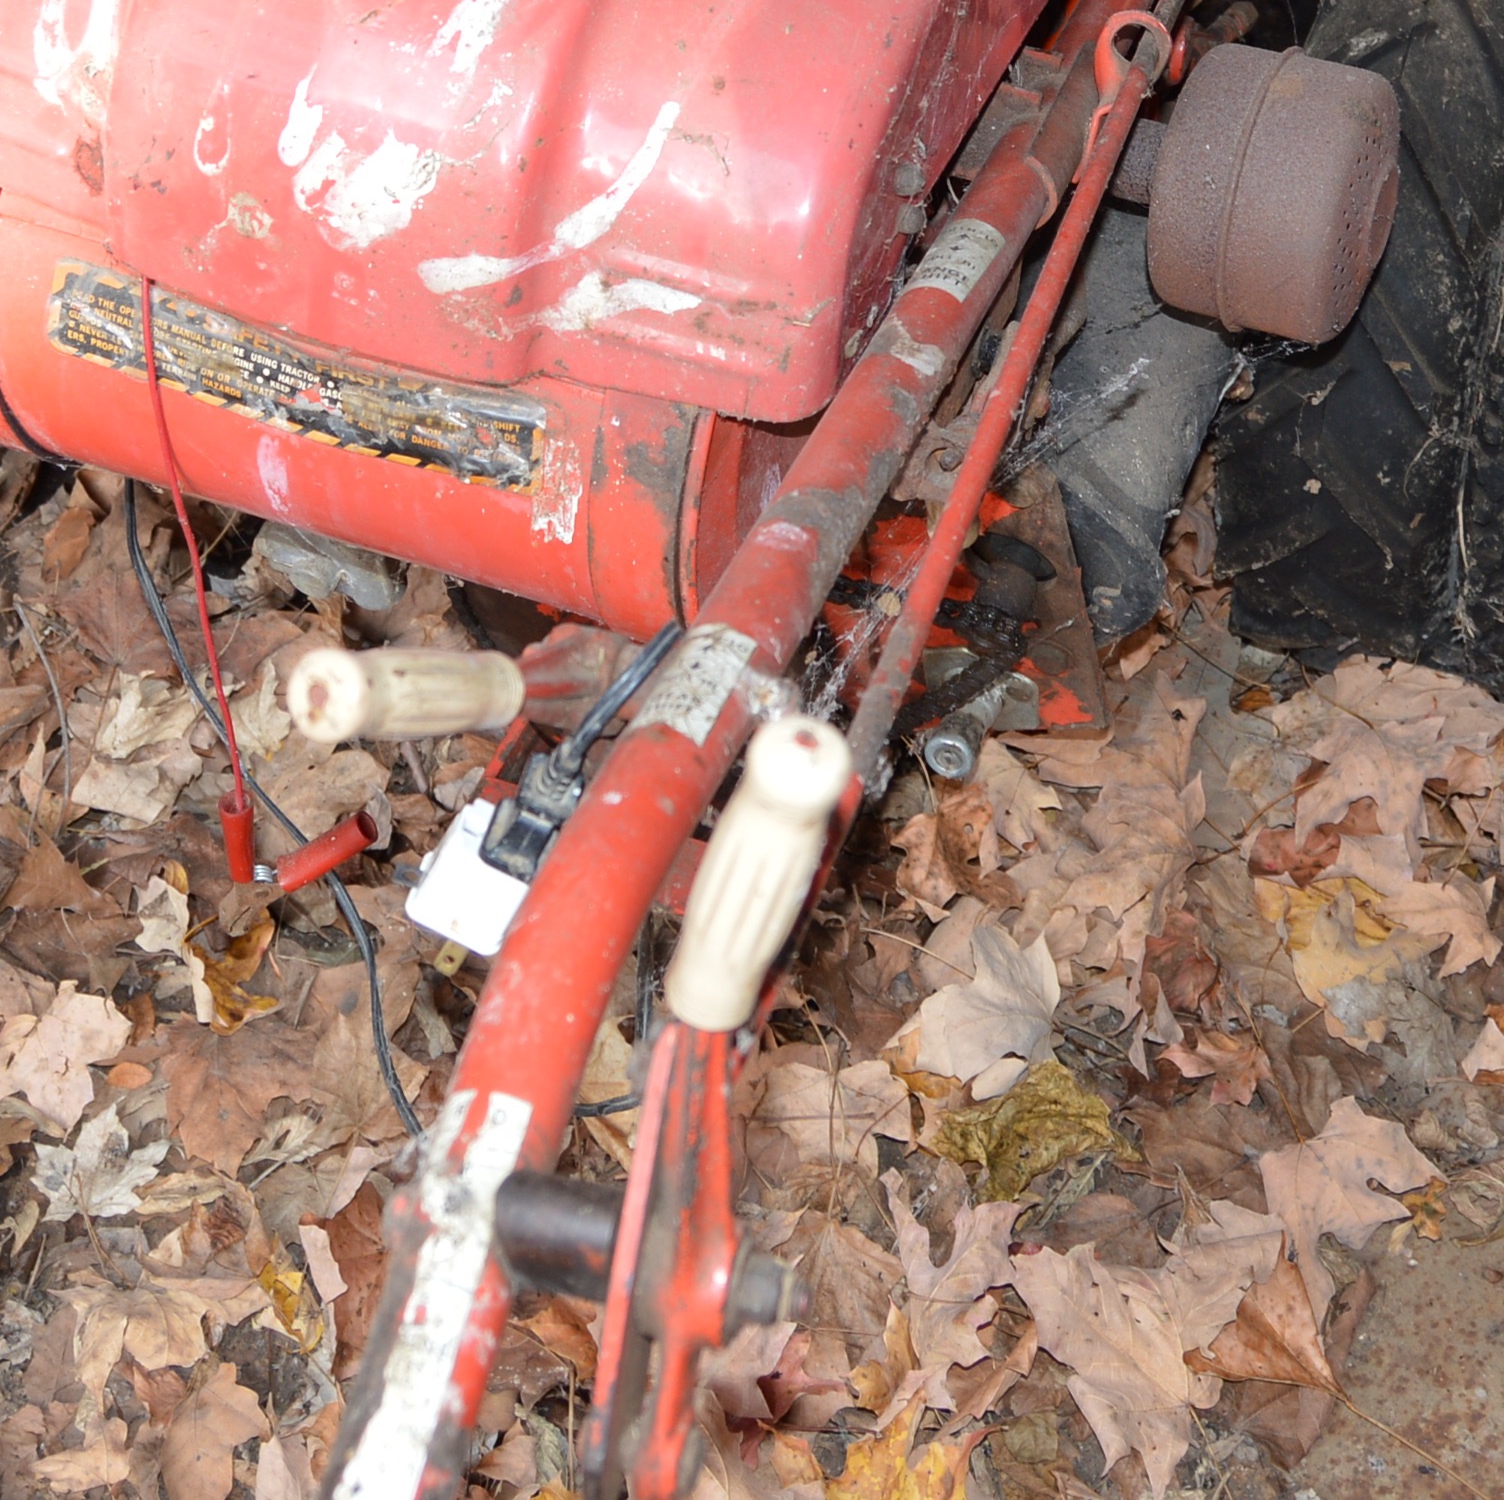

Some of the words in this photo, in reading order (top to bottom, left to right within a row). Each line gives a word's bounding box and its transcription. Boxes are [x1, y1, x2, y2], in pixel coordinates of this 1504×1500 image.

[94, 307, 134, 328] NEUTRAL
[98, 297, 115, 310] THE
[171, 324, 207, 344] MANUAL
[211, 338, 245, 358] BEFORE
[250, 352, 278, 369] USING
[280, 362, 320, 384] TRACTOR
[493, 420, 521, 433] SHIFT
[316, 363, 390, 390] FIRST
[200, 367, 215, 378] ON
[217, 371, 231, 383] OR
[236, 378, 276, 398] OPERATE
[202, 378, 243, 399] HAZARDS
[269, 380, 291, 394] KEEP
